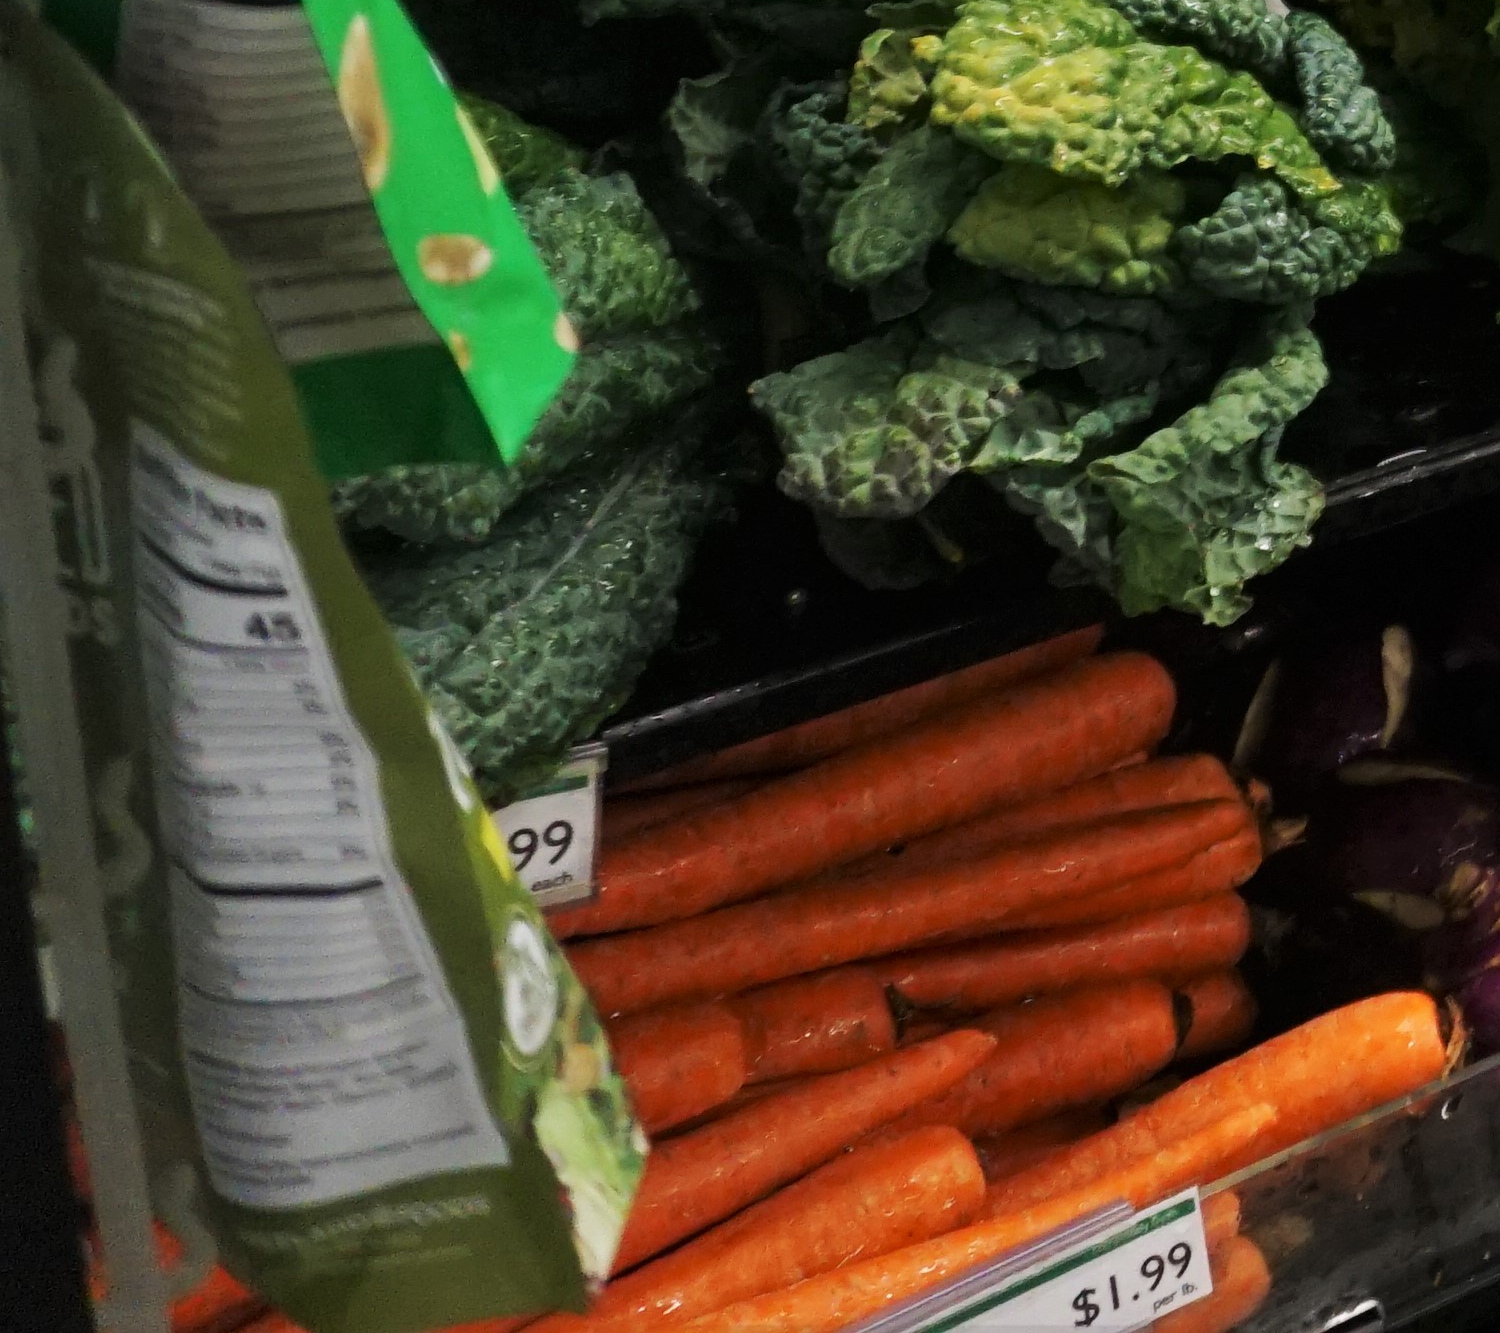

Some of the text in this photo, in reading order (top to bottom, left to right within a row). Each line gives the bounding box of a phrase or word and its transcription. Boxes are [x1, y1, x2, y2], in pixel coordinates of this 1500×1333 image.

[531, 871, 573, 892] each
[1073, 1241, 1193, 1327] $1.99
[1153, 1282, 1198, 1313] per lb.
